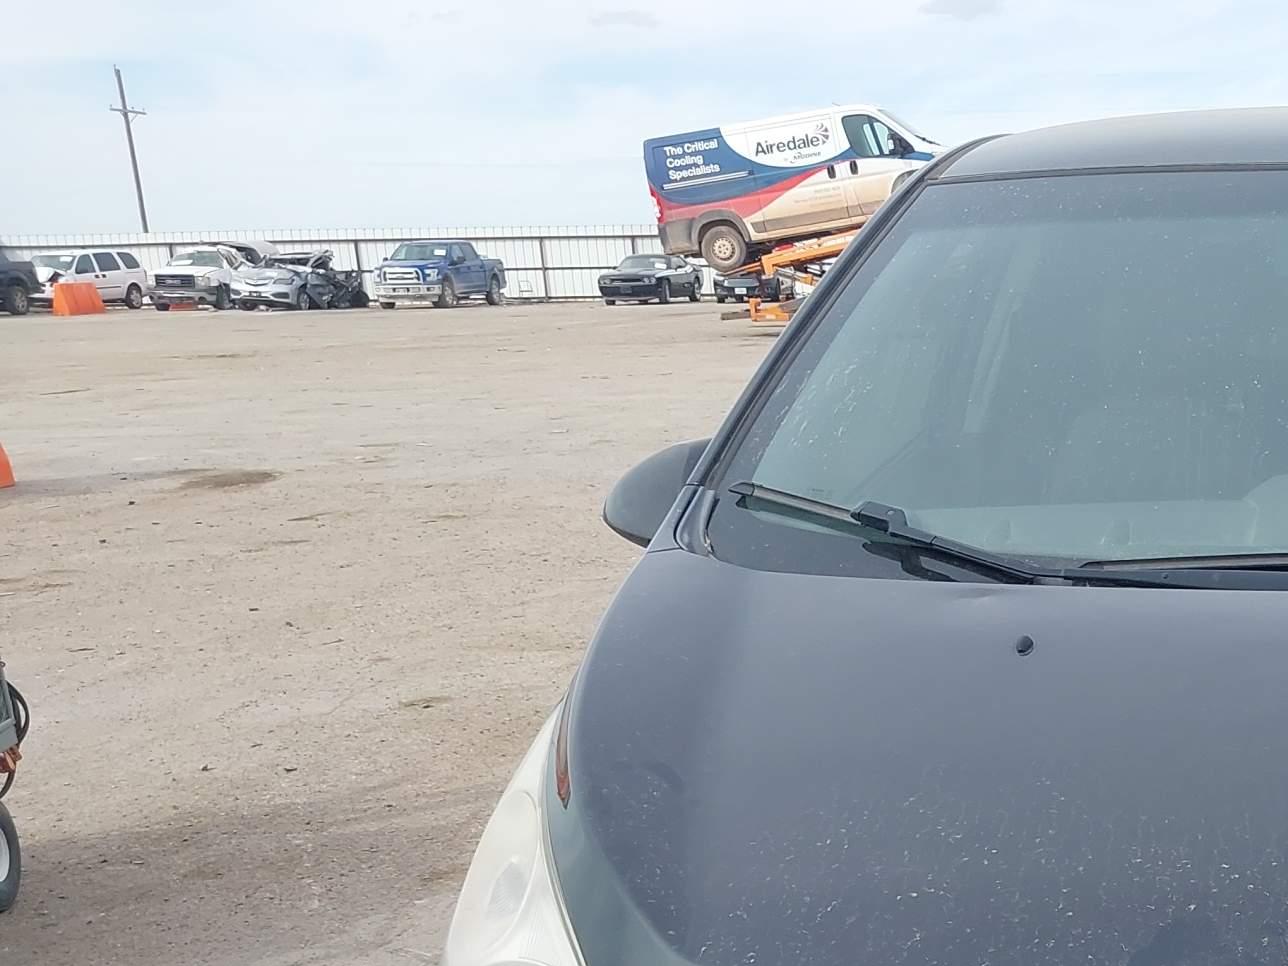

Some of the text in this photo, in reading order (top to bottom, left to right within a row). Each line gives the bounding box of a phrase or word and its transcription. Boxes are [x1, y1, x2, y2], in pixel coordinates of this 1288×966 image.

[664, 139, 718, 158] The Critical
[755, 133, 821, 158] Airedale
[666, 156, 704, 168] Cooling
[668, 166, 721, 182] Specialists
